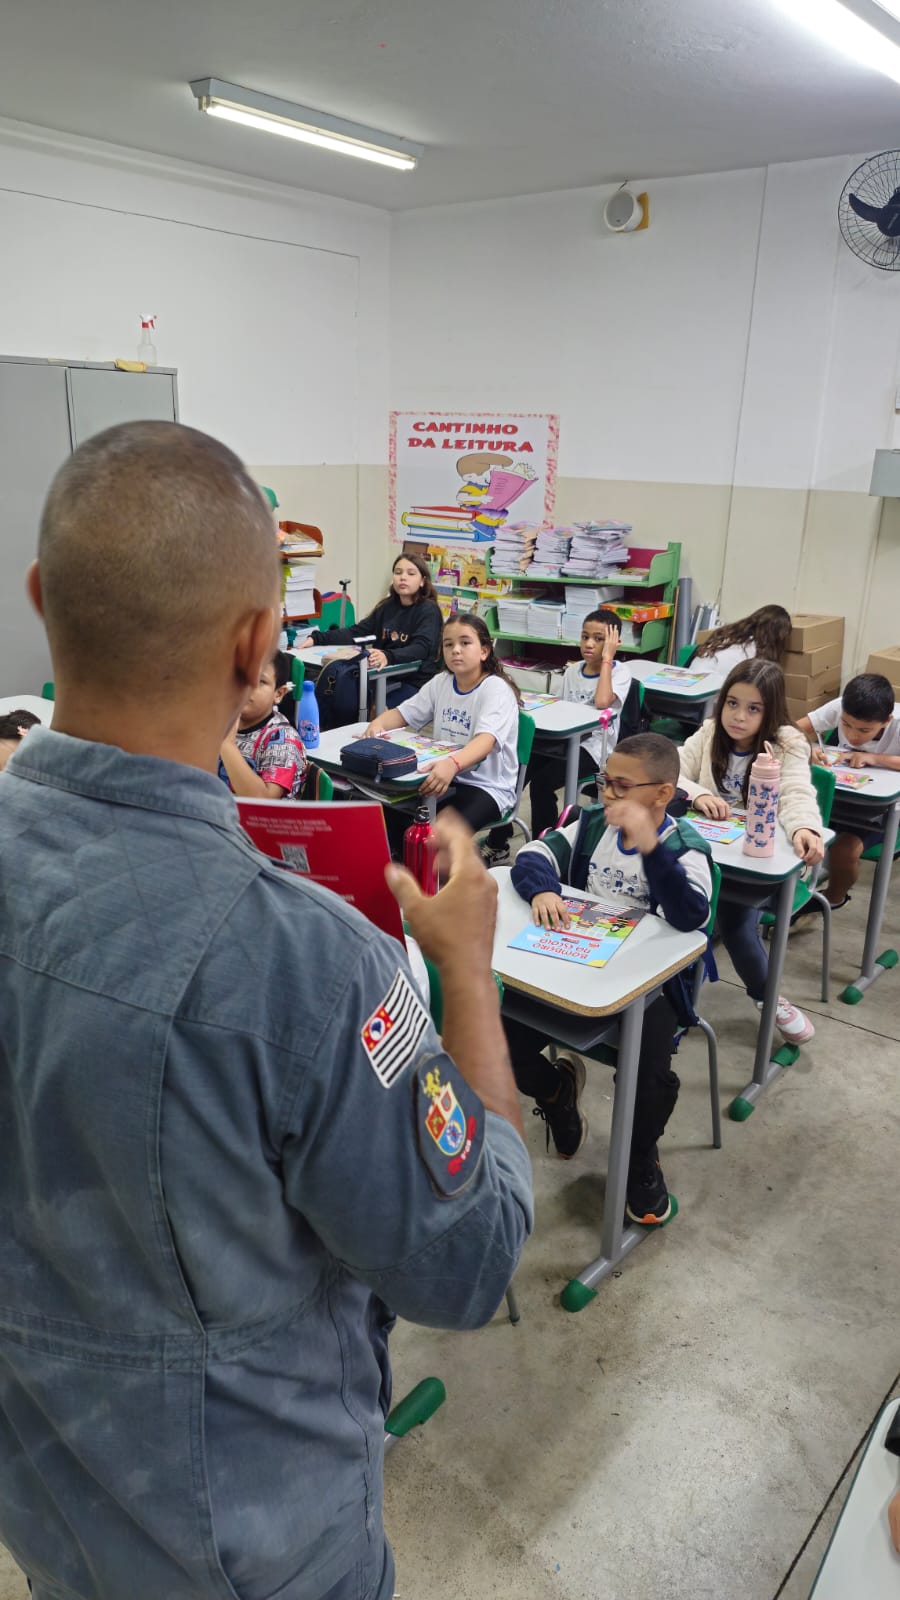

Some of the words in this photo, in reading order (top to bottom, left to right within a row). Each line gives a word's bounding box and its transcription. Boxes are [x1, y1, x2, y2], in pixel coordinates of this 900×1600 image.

[412, 421, 518, 435] CANTINHO
[408, 437, 436, 448] DA
[442, 438, 533, 452] LEITURA
